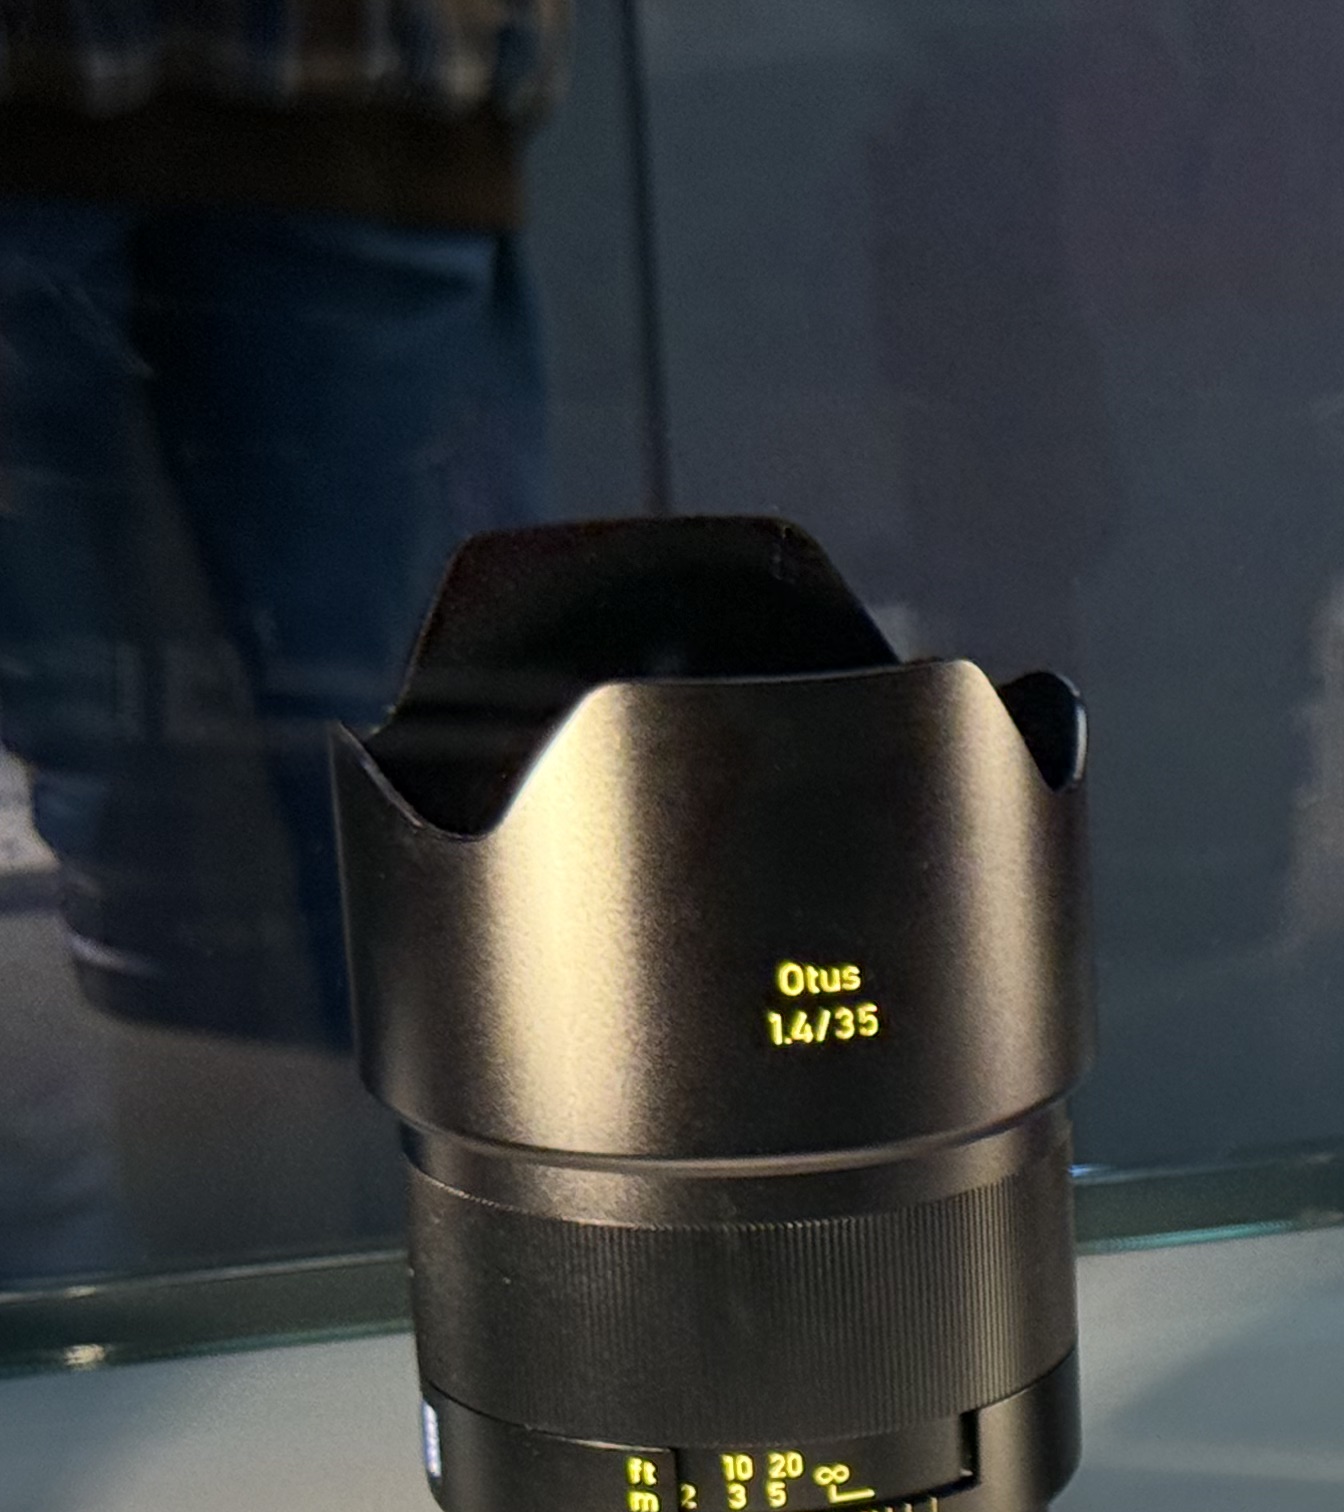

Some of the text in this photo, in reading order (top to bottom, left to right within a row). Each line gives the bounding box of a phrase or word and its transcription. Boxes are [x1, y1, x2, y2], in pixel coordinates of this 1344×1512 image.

[777, 961, 862, 997] Otus
[767, 1002, 880, 1046] 1.4/35
[626, 1456, 658, 1485] ft
[721, 1453, 754, 1482] 10
[768, 1451, 805, 1479] 20
[680, 1482, 698, 1510] 2
[727, 1482, 747, 1510] 3
[767, 1480, 787, 1508] 5
